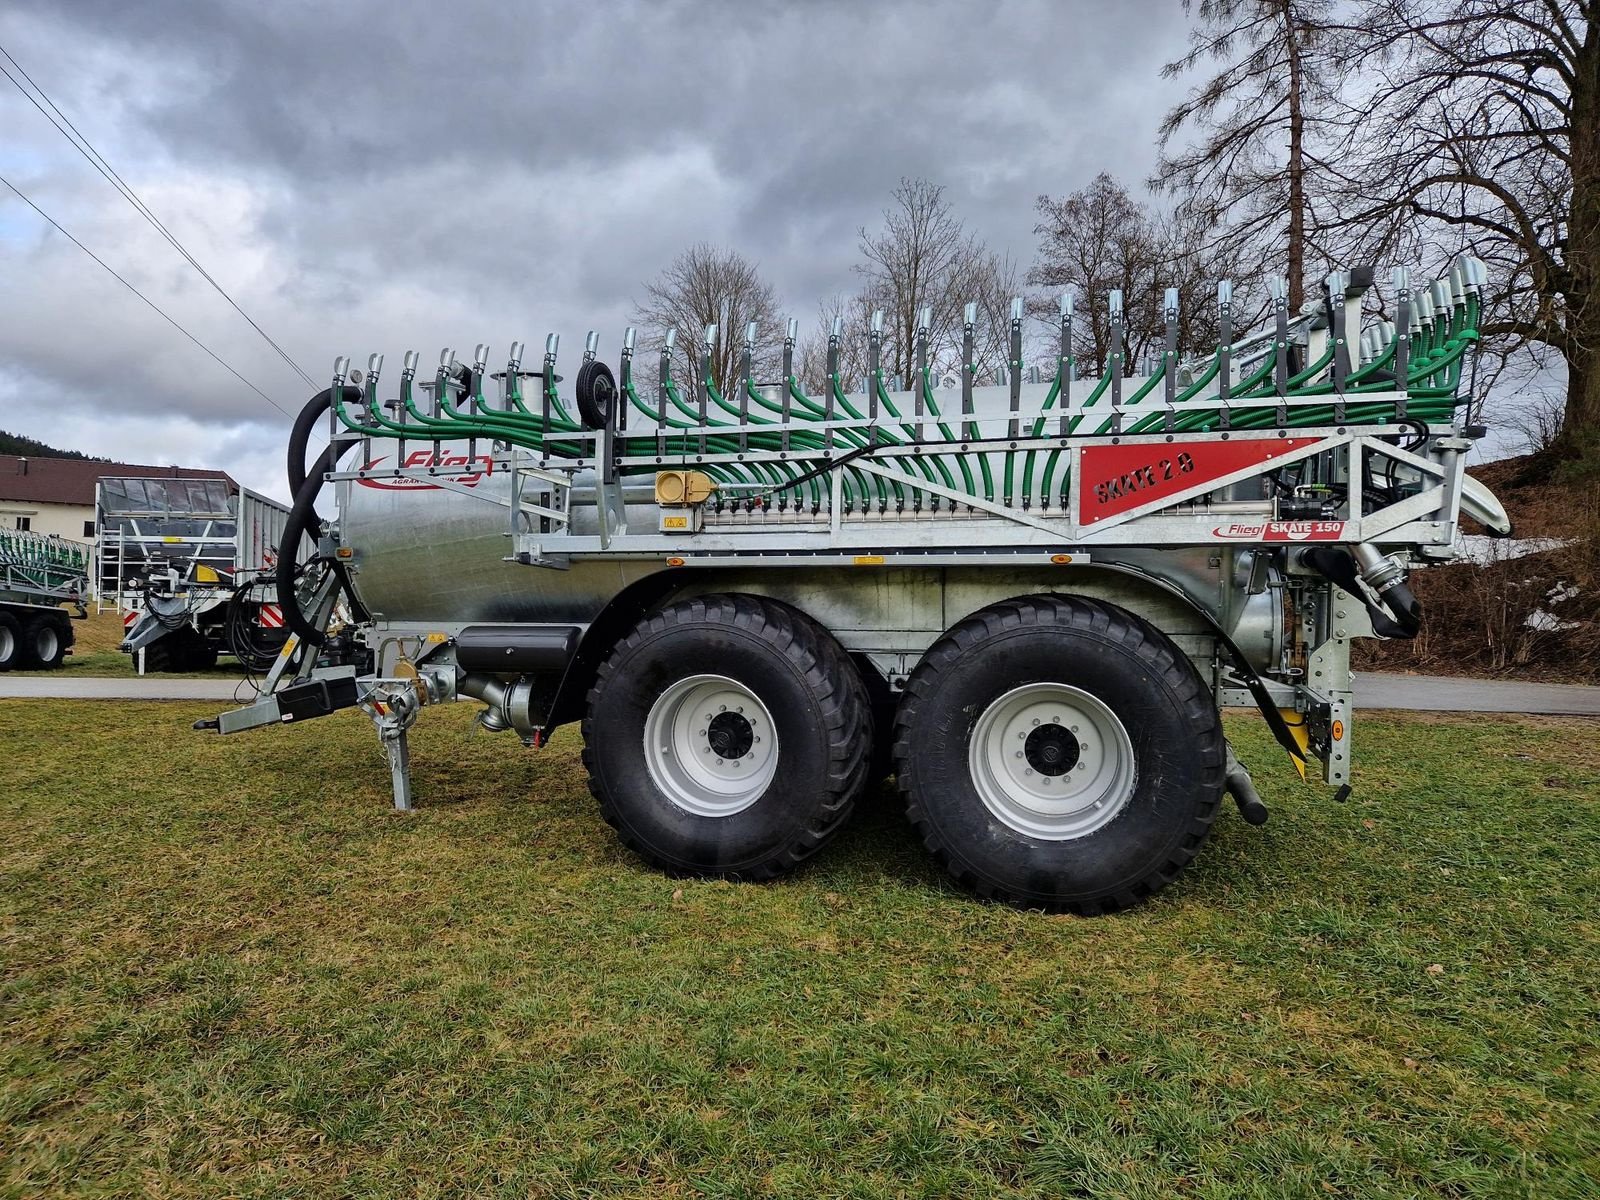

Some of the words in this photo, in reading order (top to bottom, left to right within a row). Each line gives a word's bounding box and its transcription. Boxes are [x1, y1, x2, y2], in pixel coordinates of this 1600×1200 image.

[1093, 464, 1156, 504] SKATE
[1228, 523, 1264, 536] Fliegl
[1270, 522, 1312, 533] SKATE
[1315, 522, 1341, 532] 150
